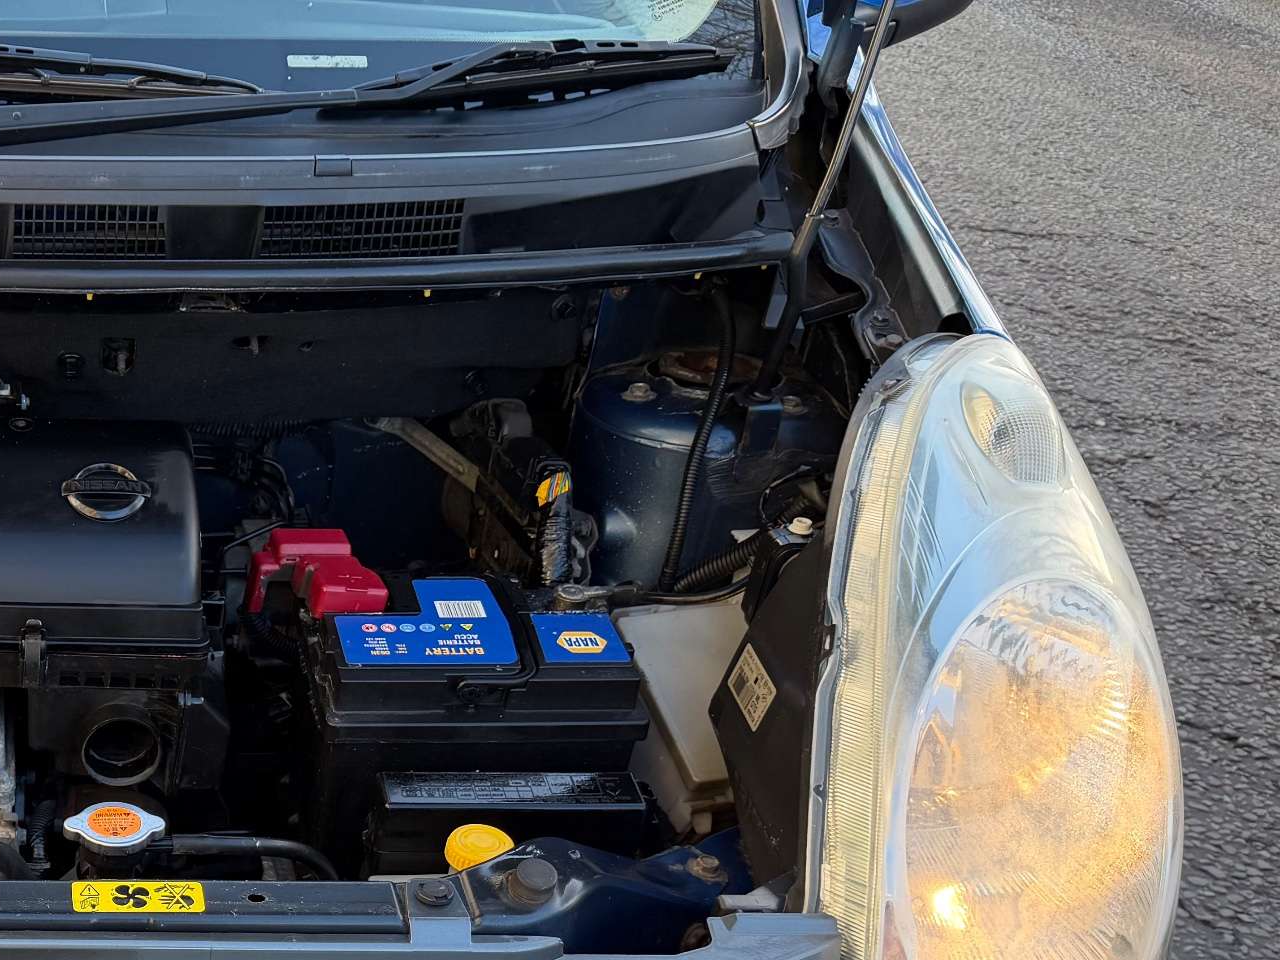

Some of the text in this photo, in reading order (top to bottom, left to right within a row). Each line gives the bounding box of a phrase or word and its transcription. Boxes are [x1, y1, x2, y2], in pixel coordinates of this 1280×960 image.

[70, 480, 140, 491] NISSAN
[563, 637, 600, 647] NAPA
[425, 647, 485, 656] BATTERY
